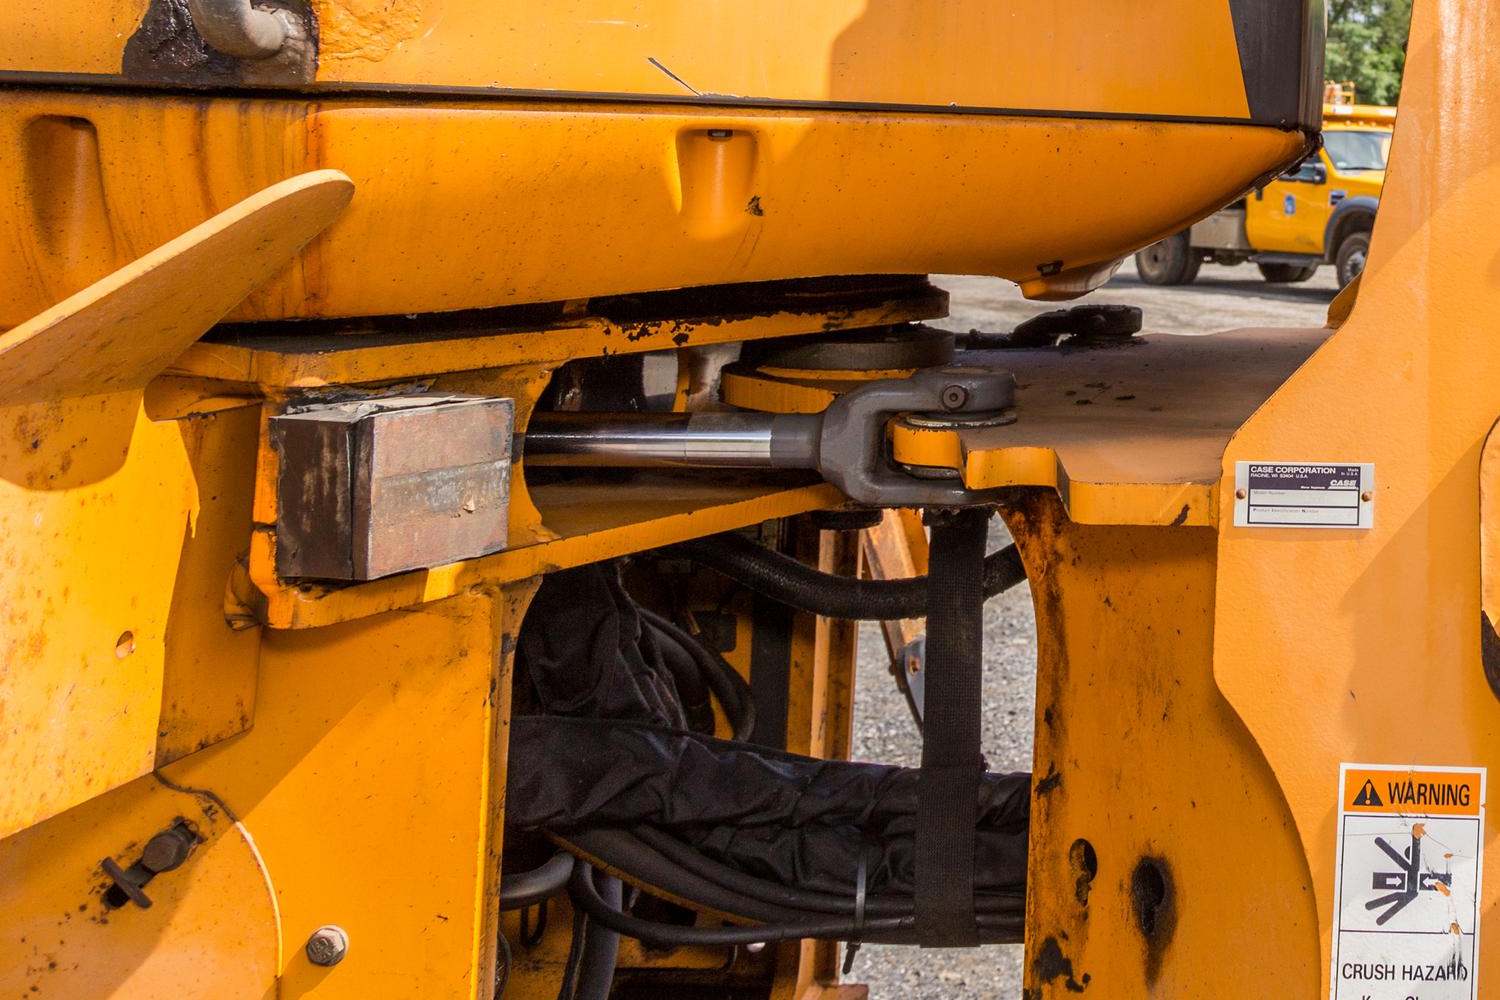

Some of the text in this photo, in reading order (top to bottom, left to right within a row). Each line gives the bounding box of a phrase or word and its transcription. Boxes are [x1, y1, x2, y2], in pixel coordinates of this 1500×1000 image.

[1388, 782, 1470, 806] WARNING
[1342, 963, 1468, 981] CRUSH HAZARD
